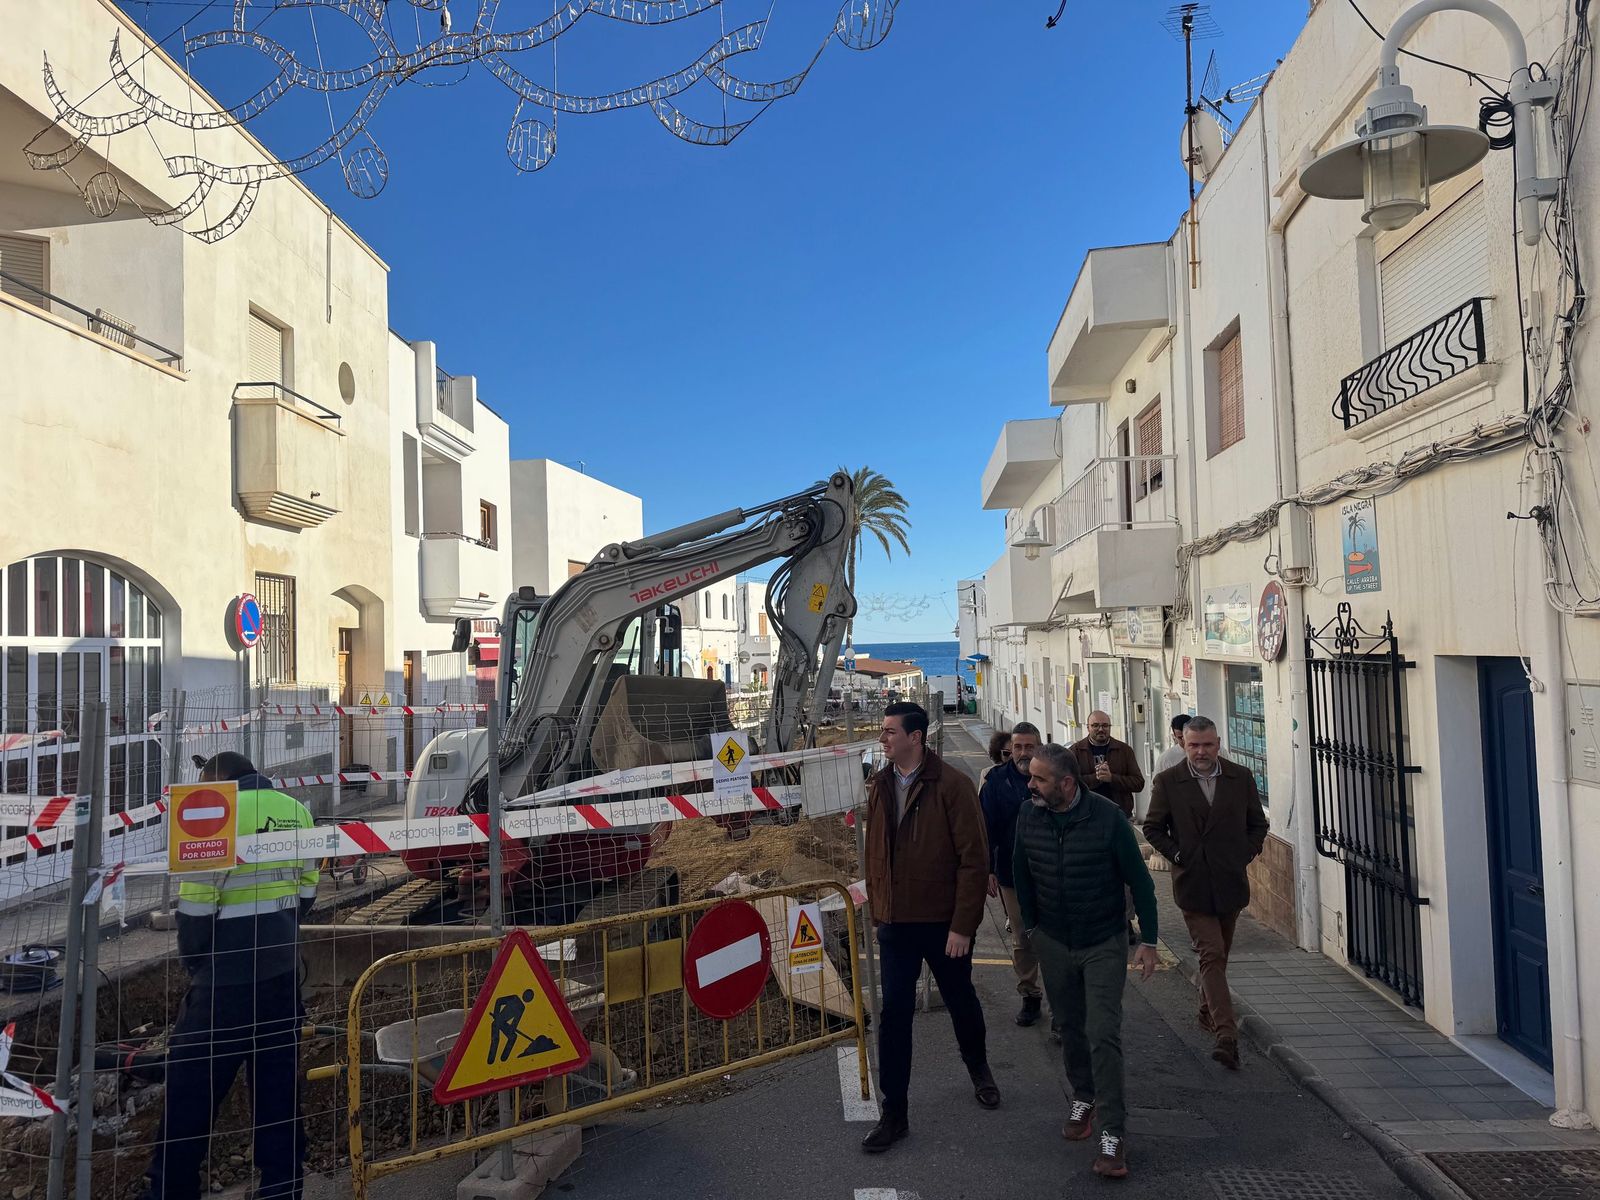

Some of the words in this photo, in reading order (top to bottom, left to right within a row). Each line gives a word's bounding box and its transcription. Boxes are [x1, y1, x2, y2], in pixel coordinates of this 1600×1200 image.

[1354, 499, 1372, 512] NEGRA
[630, 560, 720, 603] TAKEUCHI
[1346, 577, 1360, 585] CALLE
[1361, 575, 1378, 583] ARRIBA
[1362, 582, 1378, 590] STREET
[185, 840, 223, 850] CORTADO
[182, 851, 199, 859] POR
[200, 850, 225, 858] OBRAS
